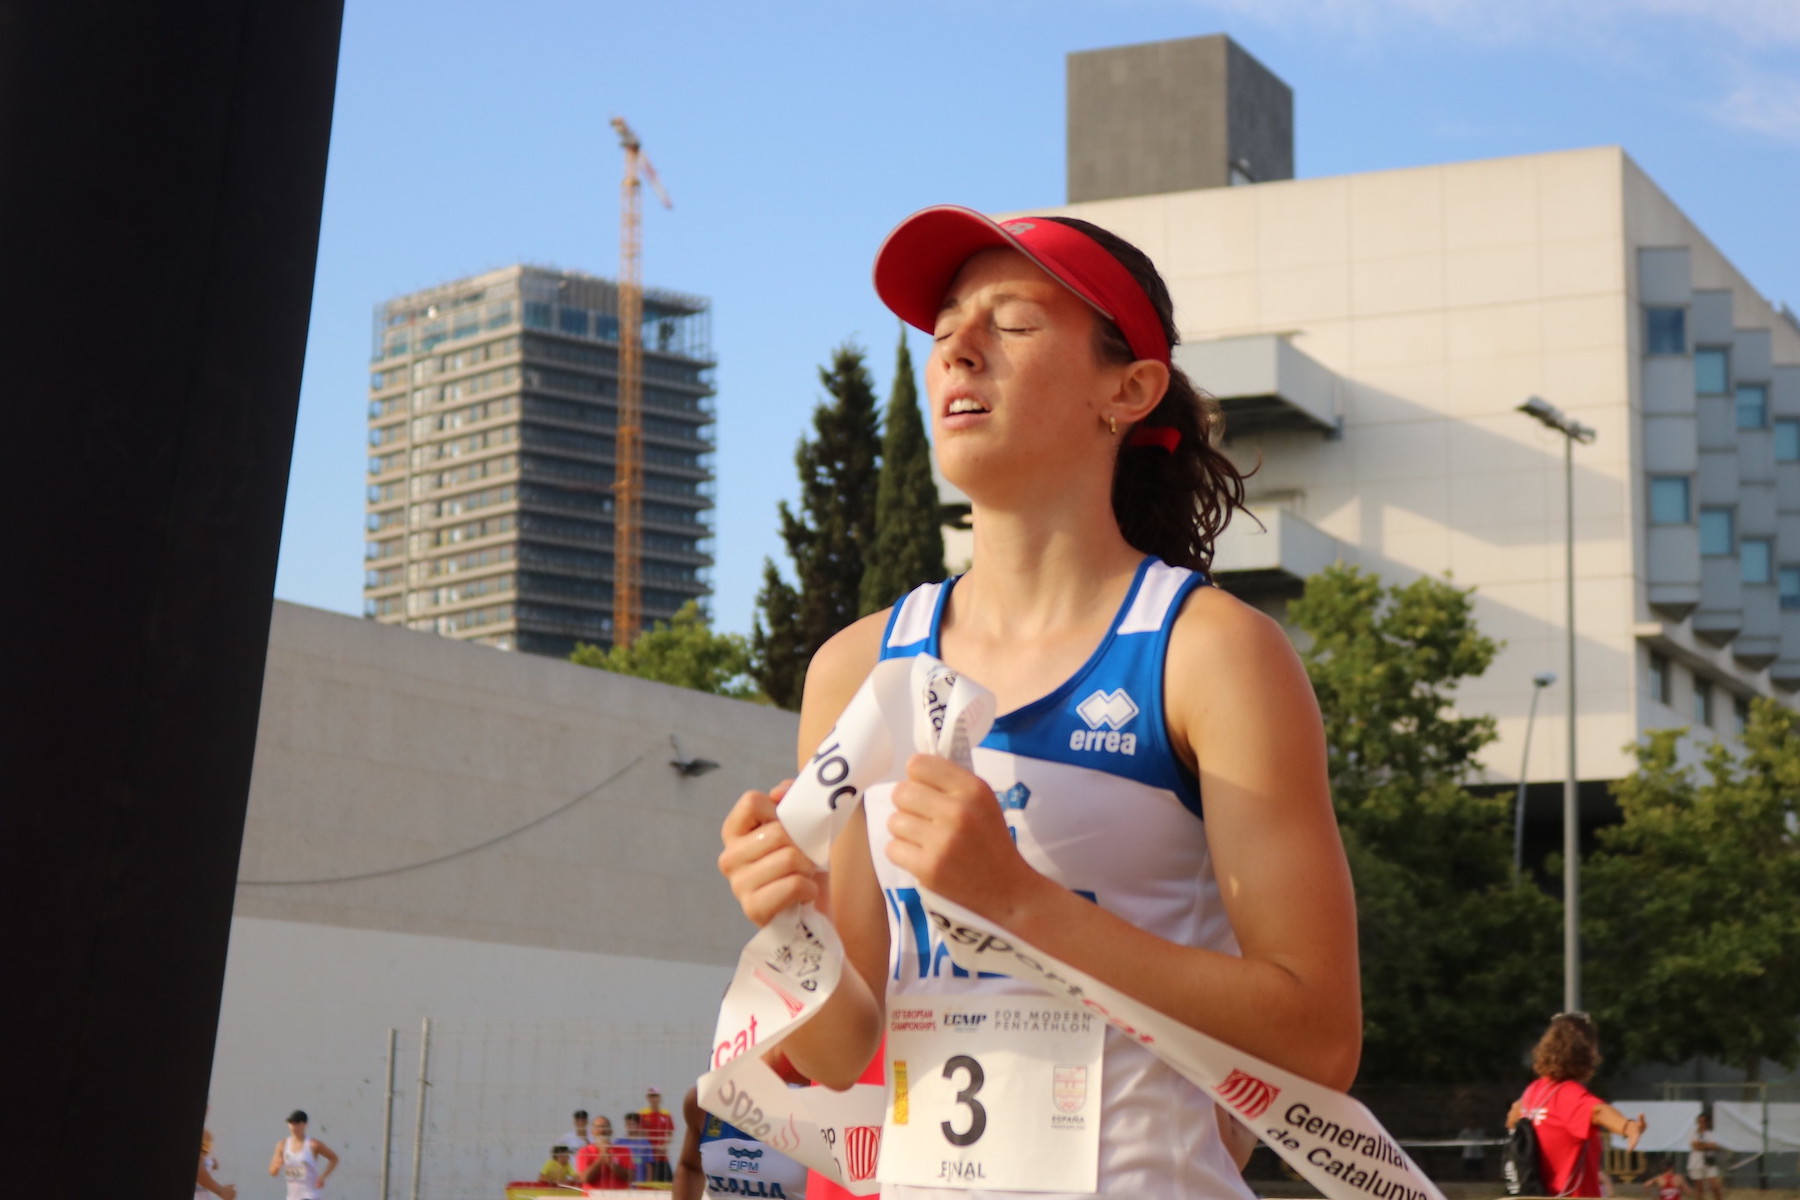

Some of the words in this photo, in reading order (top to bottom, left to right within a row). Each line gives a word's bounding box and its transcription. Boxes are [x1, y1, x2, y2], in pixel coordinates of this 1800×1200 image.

[1069, 729, 1137, 756] errea
[994, 1010, 1021, 1021] FOR
[1029, 1011, 1092, 1022] MODERN
[994, 1020, 1091, 1033] PENTATHLON
[940, 1054, 987, 1147] 3
[1266, 1127, 1301, 1152] de
[728, 1160, 759, 1172] FIPM
[940, 1160, 986, 1179] FINAL
